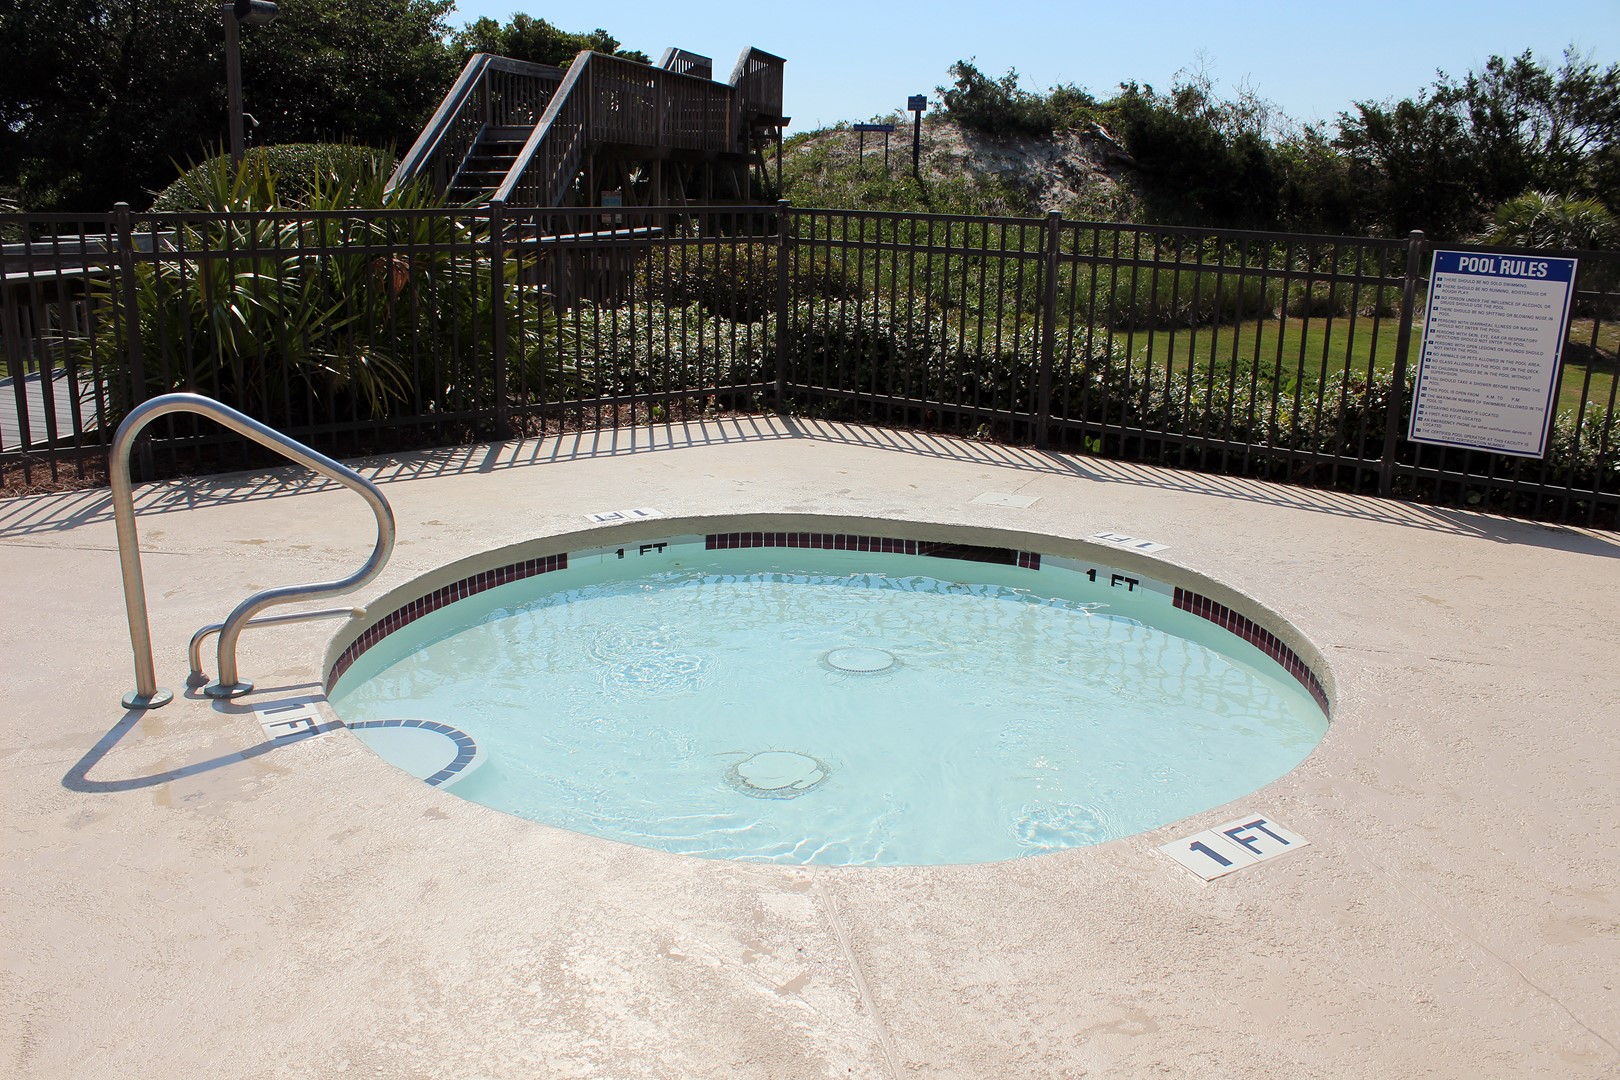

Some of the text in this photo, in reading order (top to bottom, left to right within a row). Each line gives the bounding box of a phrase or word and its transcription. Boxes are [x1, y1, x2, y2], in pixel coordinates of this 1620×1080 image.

[1458, 257, 1548, 277] POOL RULES
[594, 512, 625, 522] FT
[1093, 533, 1132, 543] FT
[614, 542, 668, 559] 1 FT
[1086, 568, 1139, 592] 1 FT
[264, 703, 321, 739] 1 FT
[1189, 819, 1291, 867] 1 FT
